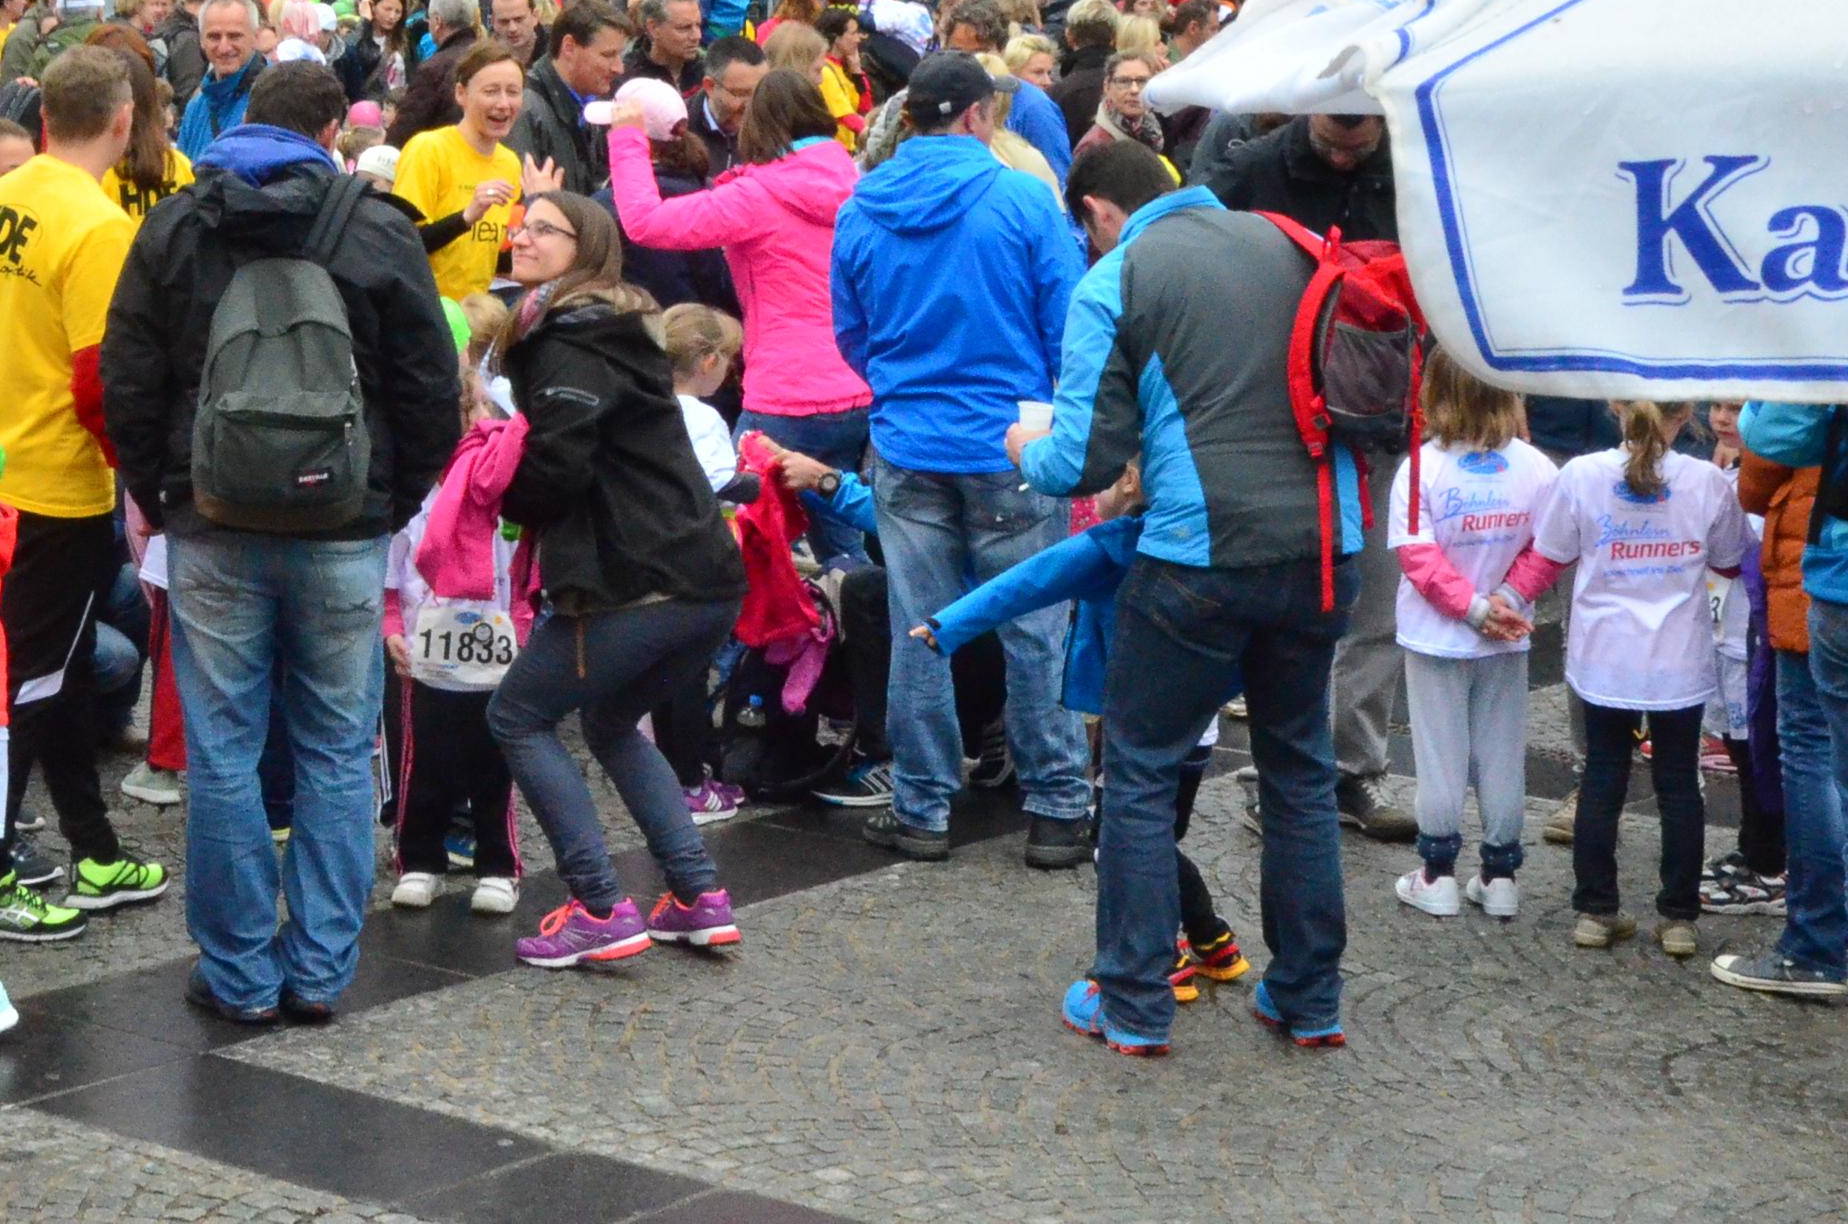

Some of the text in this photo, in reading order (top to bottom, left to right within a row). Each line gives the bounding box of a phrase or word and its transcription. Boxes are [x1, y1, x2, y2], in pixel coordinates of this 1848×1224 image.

[1462, 512, 1530, 533] Runners
[1610, 540, 1701, 561] Runners
[419, 628, 513, 666] 11833
